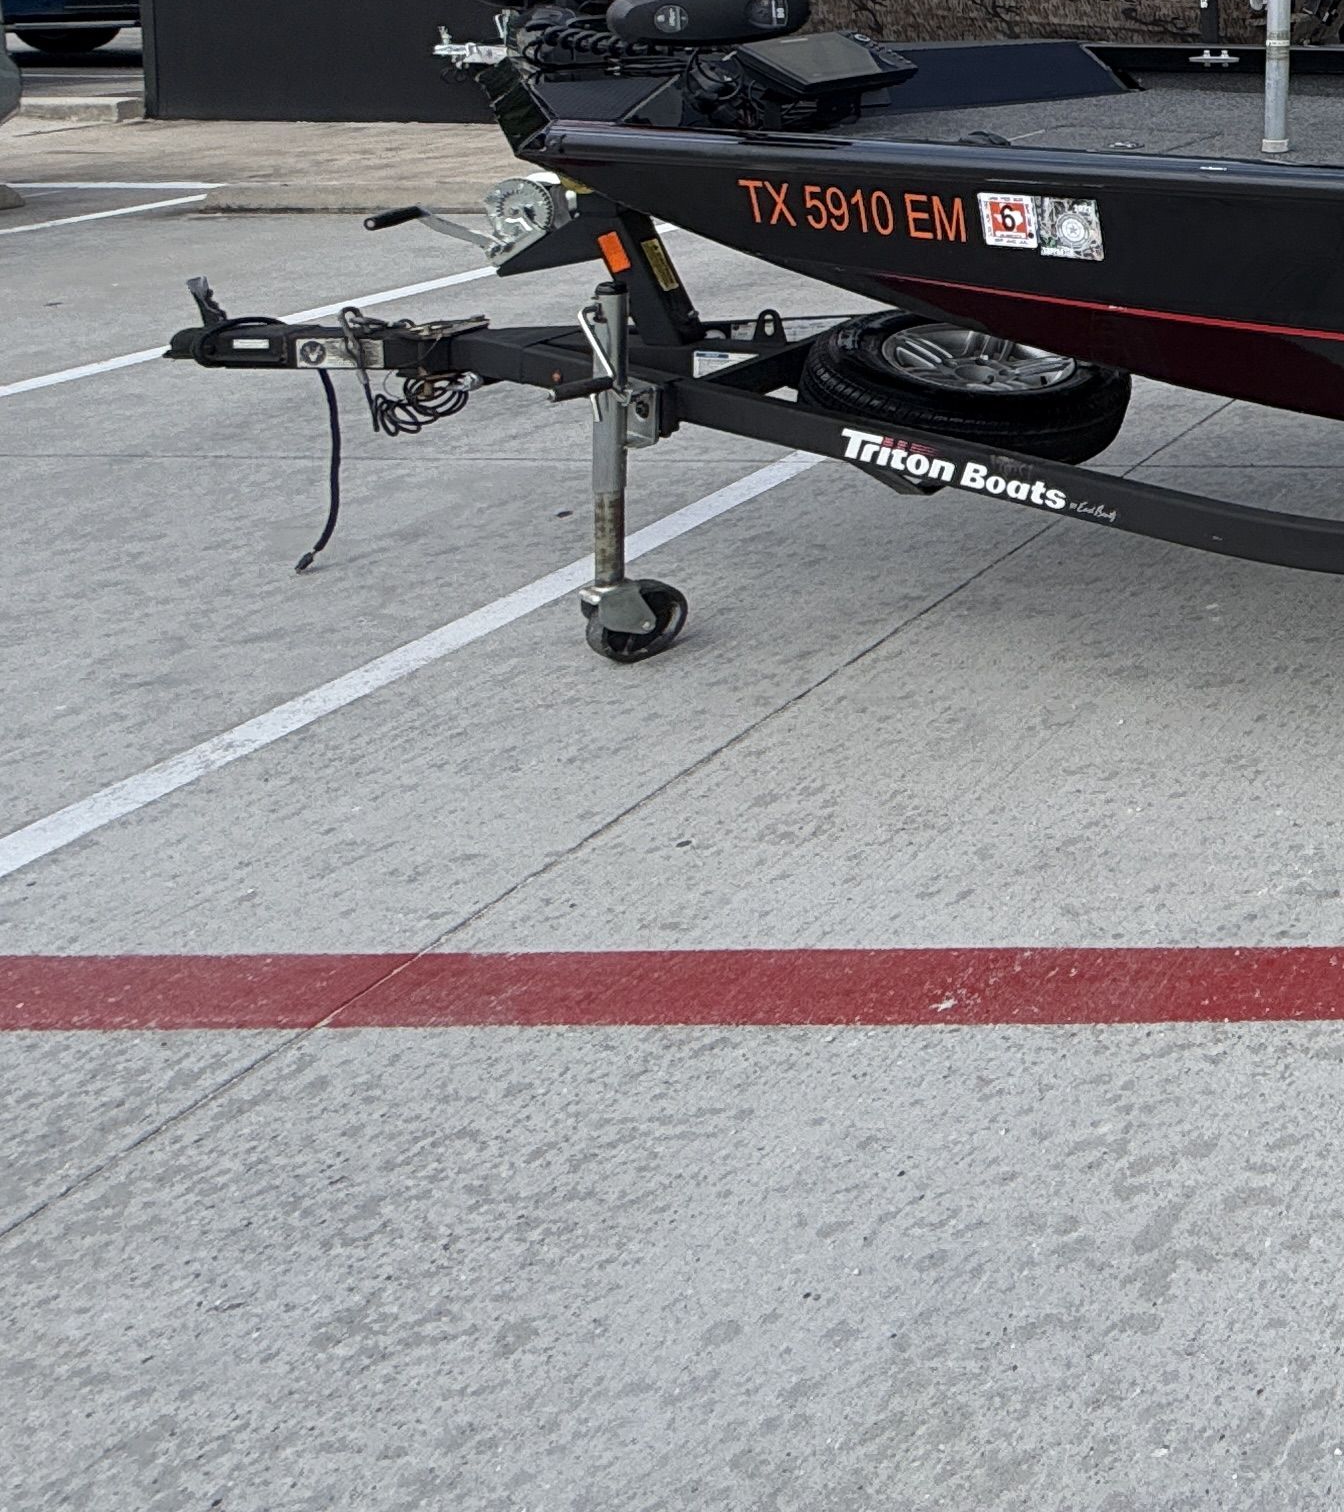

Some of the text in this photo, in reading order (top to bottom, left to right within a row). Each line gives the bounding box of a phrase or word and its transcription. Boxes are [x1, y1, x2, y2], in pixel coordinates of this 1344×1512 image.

[738, 179, 967, 242] TX 5910 EM
[1000, 204, 1016, 232] 6
[841, 428, 1067, 510] Triton Boats
